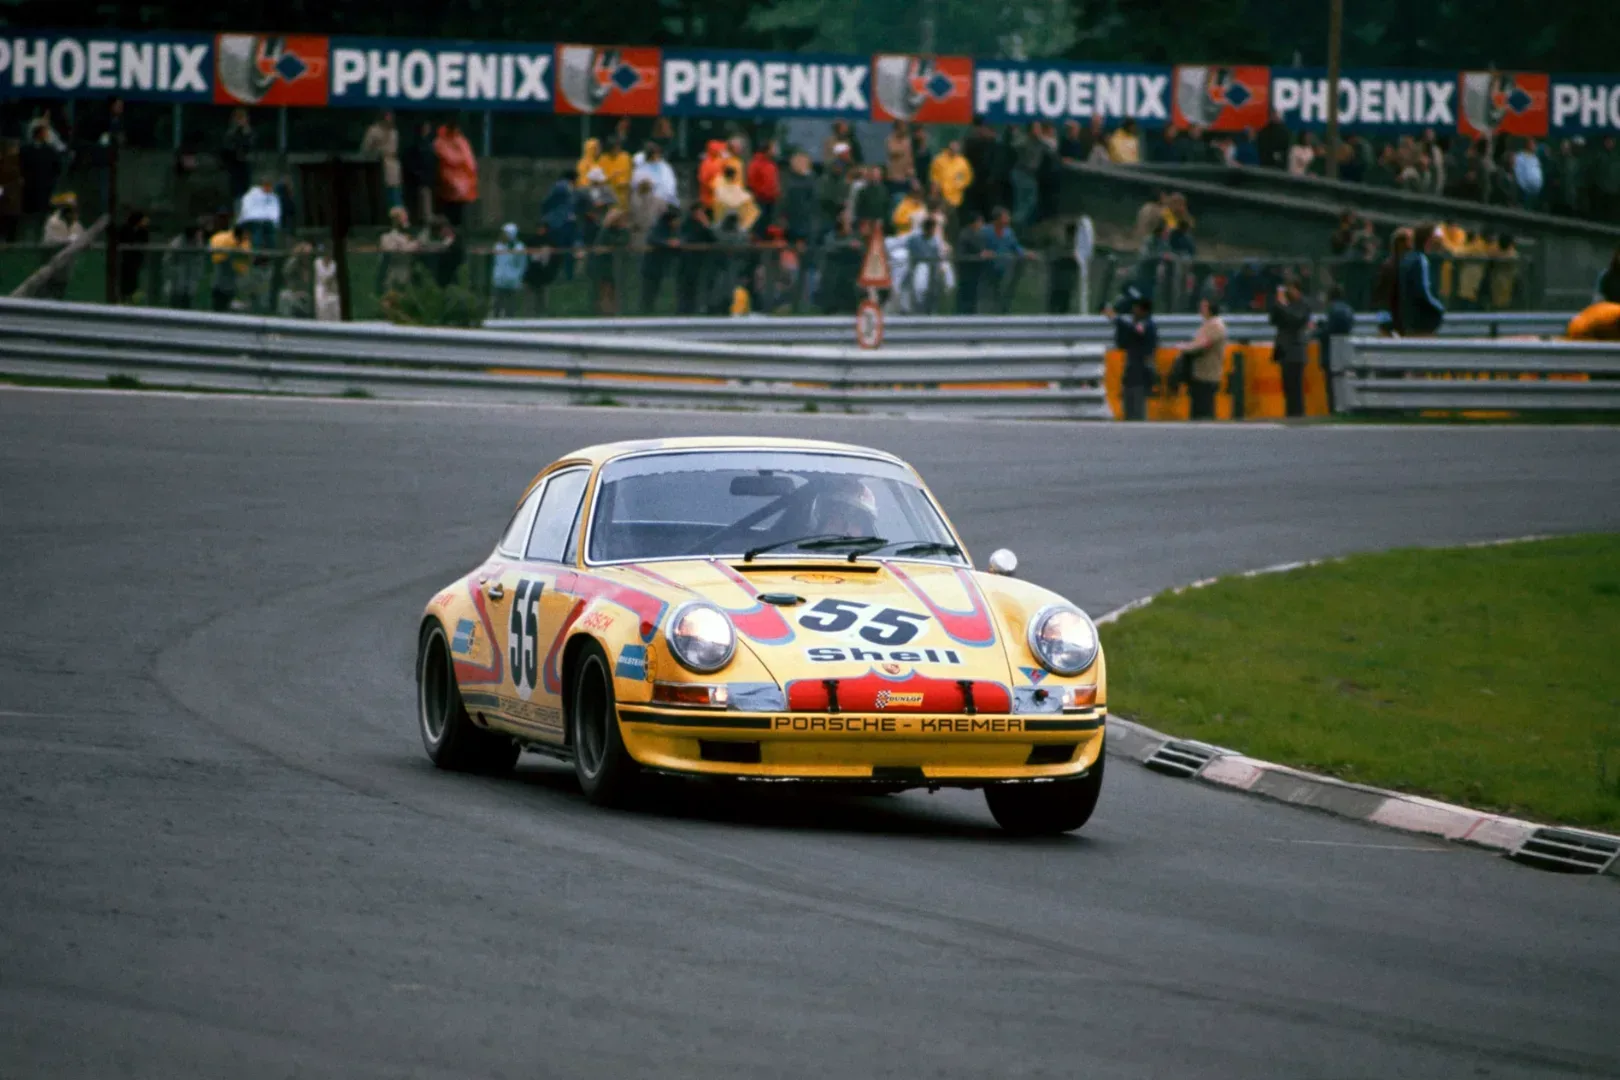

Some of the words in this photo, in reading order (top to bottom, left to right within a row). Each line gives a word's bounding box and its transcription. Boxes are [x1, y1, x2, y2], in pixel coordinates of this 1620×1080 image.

[332, 48, 551, 101] PHOENIX
[664, 59, 867, 110] PHOENIX
[974, 69, 1168, 119] PHOENIX
[1272, 78, 1455, 125] PHOENIX
[510, 578, 545, 690] 55
[798, 597, 931, 646] 55
[807, 648, 960, 663] Shell
[774, 717, 896, 731] PORSCHE
[921, 719, 1024, 732] KREMER
